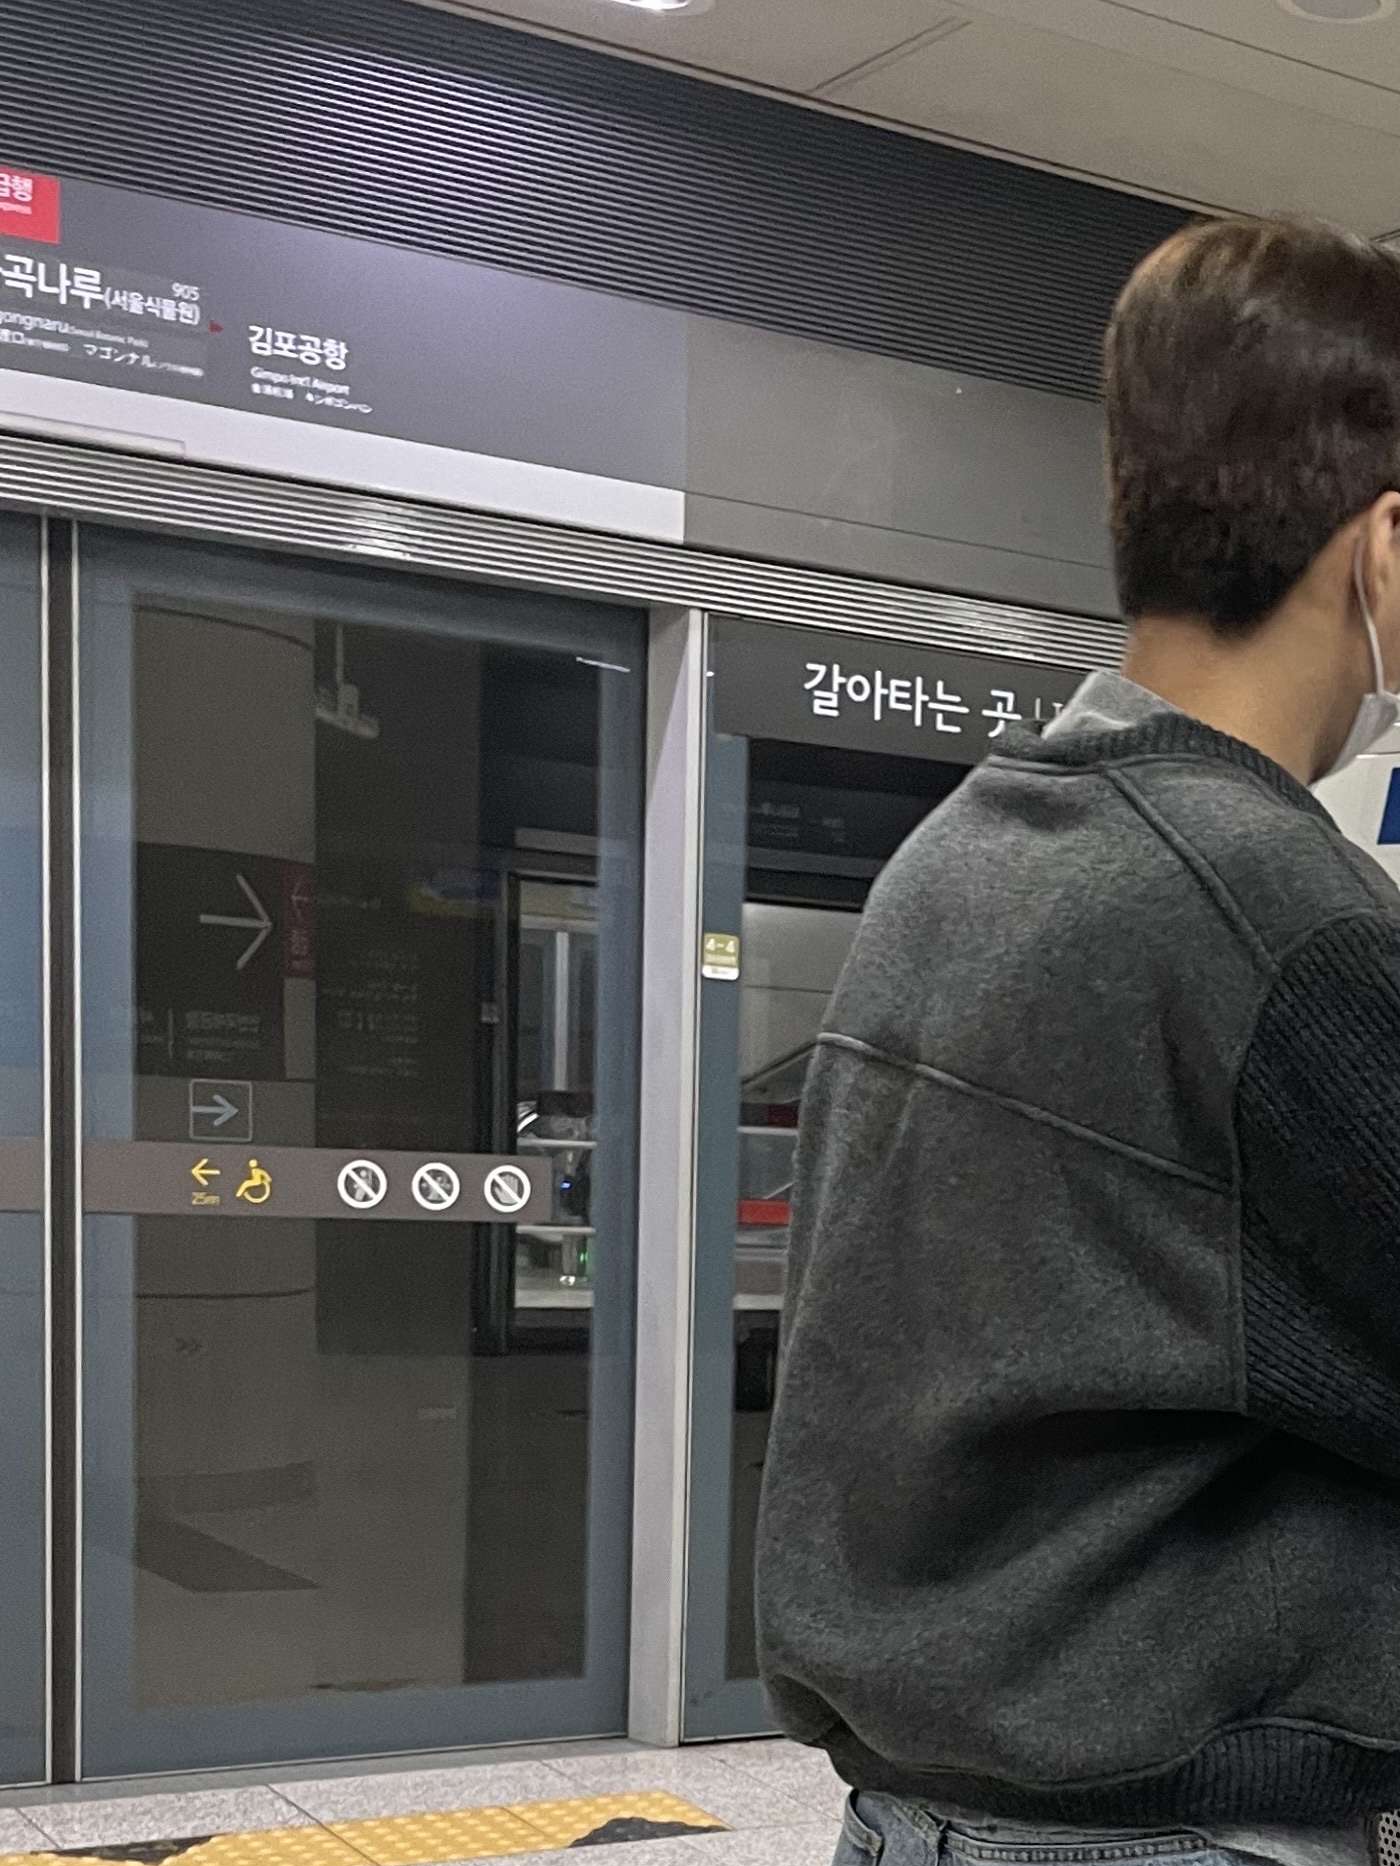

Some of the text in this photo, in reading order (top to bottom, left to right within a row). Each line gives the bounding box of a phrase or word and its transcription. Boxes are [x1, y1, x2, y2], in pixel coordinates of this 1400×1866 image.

[248, 324, 350, 371] 김포공항
[803, 662, 1022, 738] 갈아타는 곳
